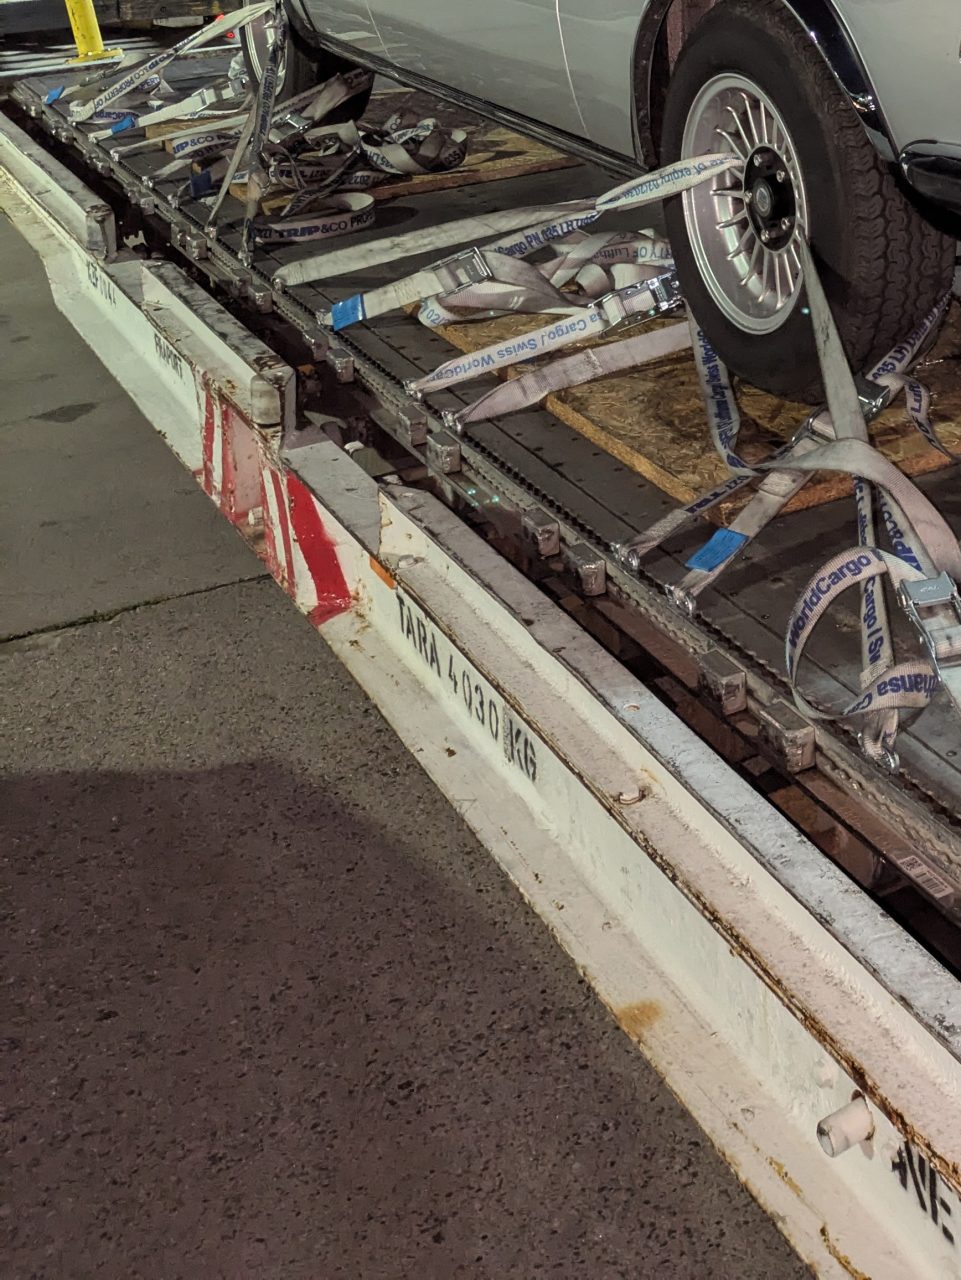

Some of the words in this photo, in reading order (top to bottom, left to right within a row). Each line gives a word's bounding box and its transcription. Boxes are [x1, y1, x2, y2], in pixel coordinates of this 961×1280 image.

[497, 338, 538, 360] Swiss
[547, 320, 588, 342] Cargo
[787, 552, 871, 650] WorldCargo
[396, 592, 441, 678] TARA
[448, 653, 500, 743] 4030
[507, 718, 538, 784] KG
